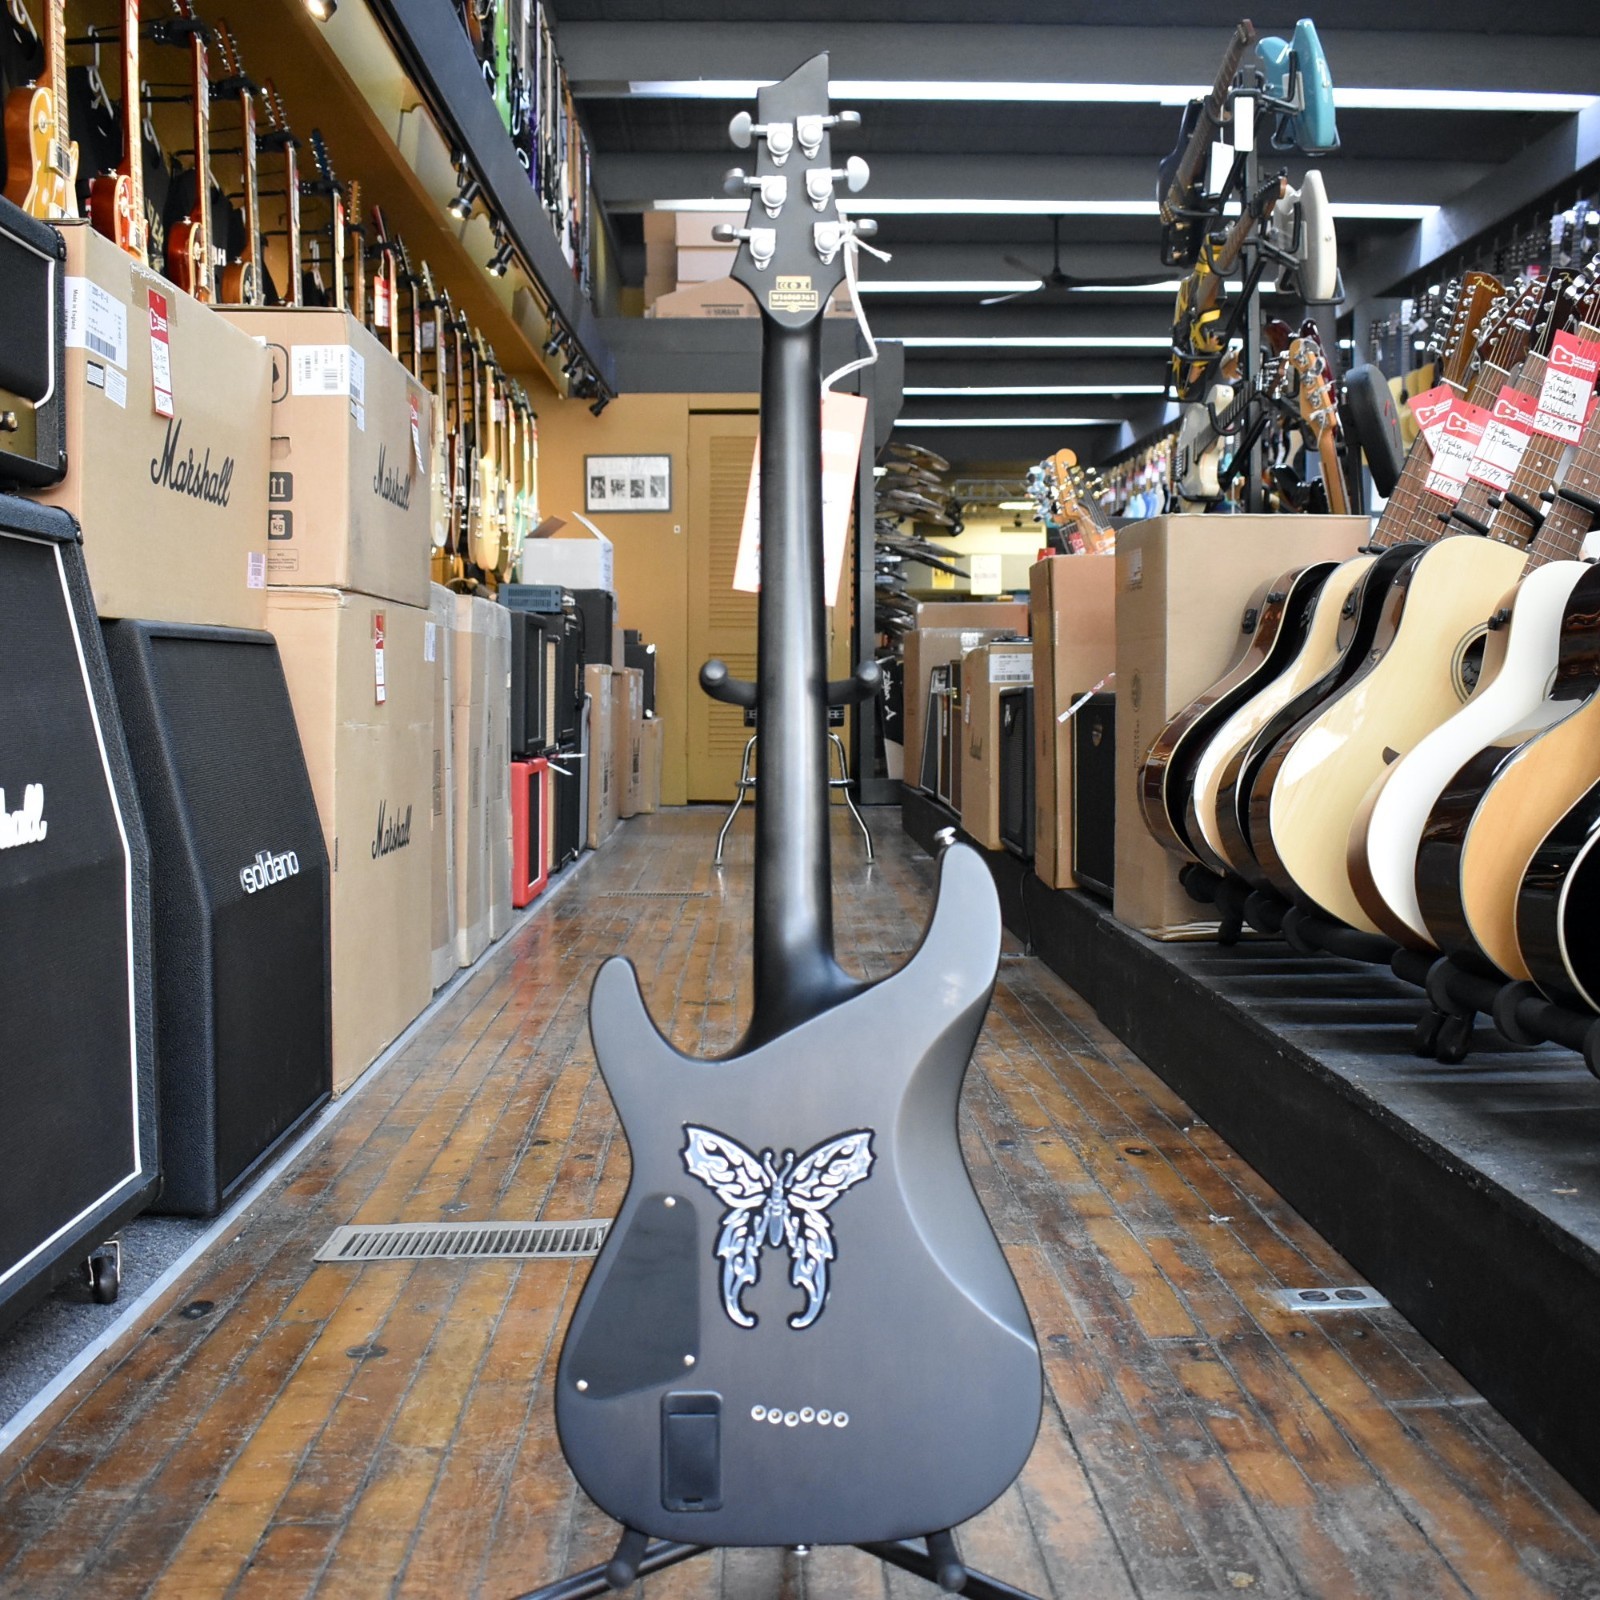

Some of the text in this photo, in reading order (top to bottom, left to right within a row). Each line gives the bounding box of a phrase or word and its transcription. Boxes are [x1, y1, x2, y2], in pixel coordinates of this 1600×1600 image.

[150, 417, 234, 507] Marshall
[373, 442, 411, 511] Marshall
[372, 799, 412, 860] Marshall
[242, 851, 300, 894] soldano
